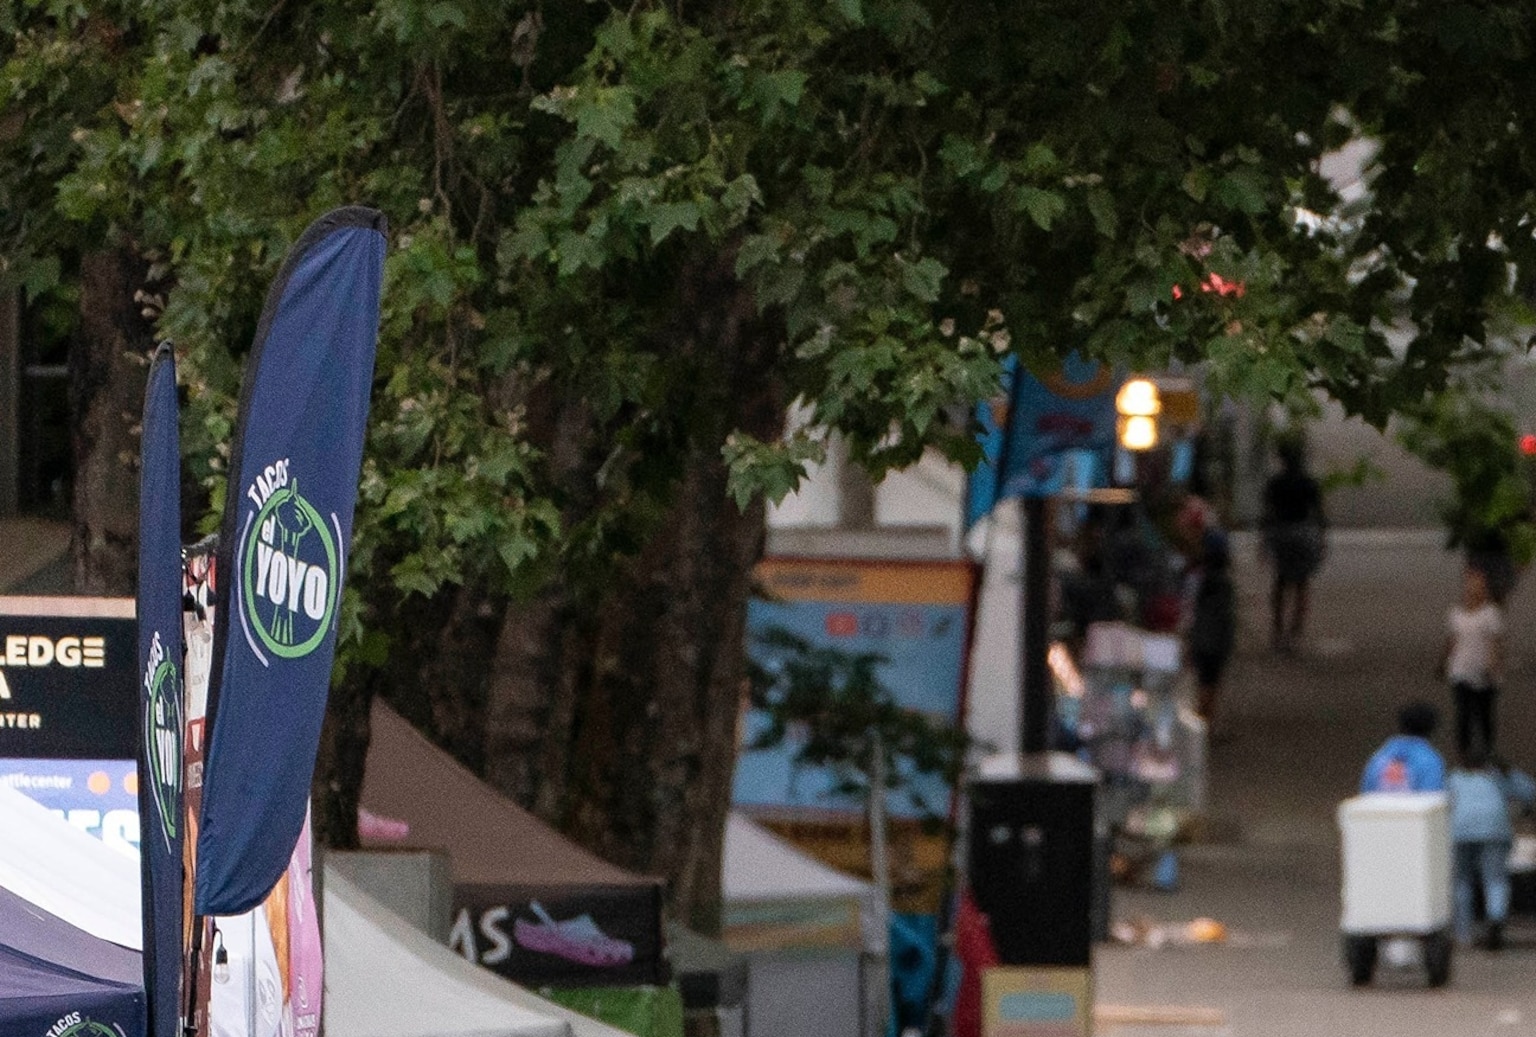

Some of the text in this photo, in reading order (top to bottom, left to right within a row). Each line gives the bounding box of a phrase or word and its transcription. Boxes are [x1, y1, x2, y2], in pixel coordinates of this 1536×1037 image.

[248, 458, 289, 510] TACOS
[261, 514, 276, 546] el
[256, 541, 328, 621] YOYO
